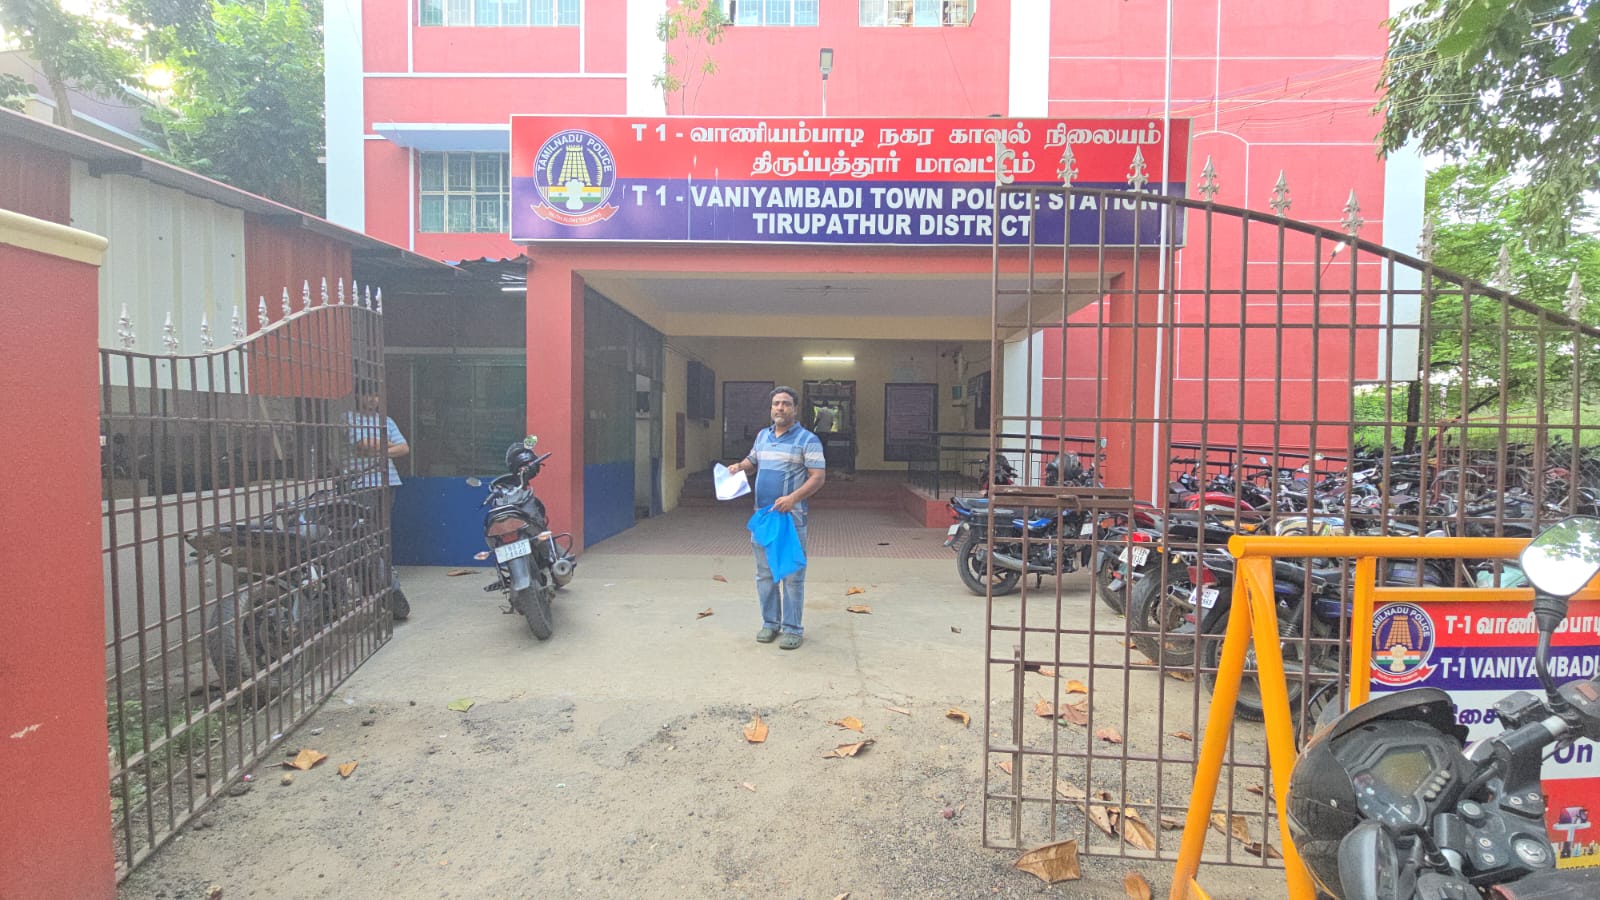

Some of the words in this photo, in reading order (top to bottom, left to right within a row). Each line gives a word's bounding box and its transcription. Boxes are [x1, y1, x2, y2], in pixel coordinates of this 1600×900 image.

[631, 123, 647, 142] T
[690, 120, 865, 147] வாணியம்பாடி
[877, 128, 934, 148] நகர
[948, 121, 1031, 144] காவல்
[1044, 121, 1161, 149] நிலையம்
[537, 133, 583, 172] TAMILNADU
[586, 138, 613, 173] POLICE
[750, 149, 901, 178] திருப்பத்தூர்
[631, 185, 647, 206] T
[690, 185, 863, 209] VANIYAMBADI
[870, 187, 943, 210] TOWN
[752, 212, 912, 237] TIRUPATHUR
[919, 214, 1032, 237] DISTRCT
[1409, 610, 1431, 638] POLICE
[1445, 615, 1472, 635] T-1
[1440, 656, 1467, 679] T-1
